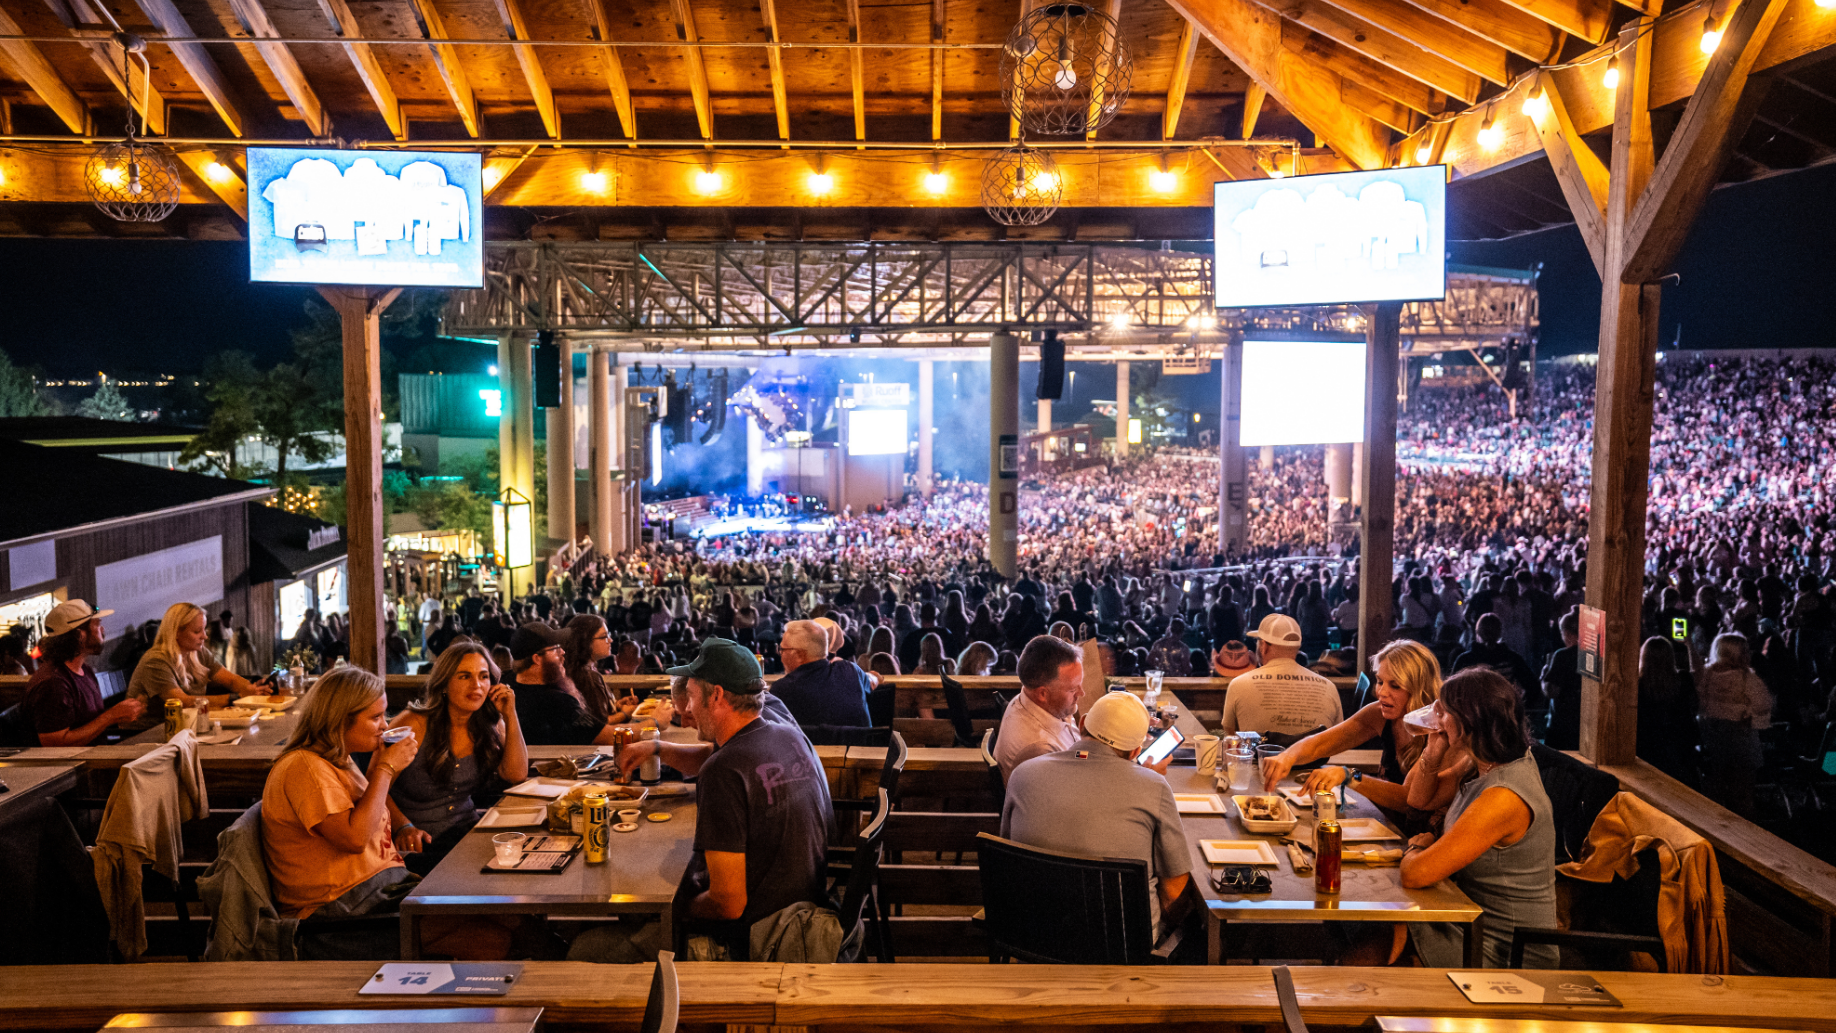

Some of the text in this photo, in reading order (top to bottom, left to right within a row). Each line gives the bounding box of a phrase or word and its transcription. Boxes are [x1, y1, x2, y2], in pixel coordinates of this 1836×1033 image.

[875, 386, 902, 396] Ruoff
[1228, 482, 1242, 501] E
[999, 492, 1016, 514] D
[106, 554, 216, 601] AWN CHAIR RENTALS
[1276, 674, 1328, 685] DOMINION
[398, 976, 429, 985] 14
[1489, 985, 1523, 994] 15
